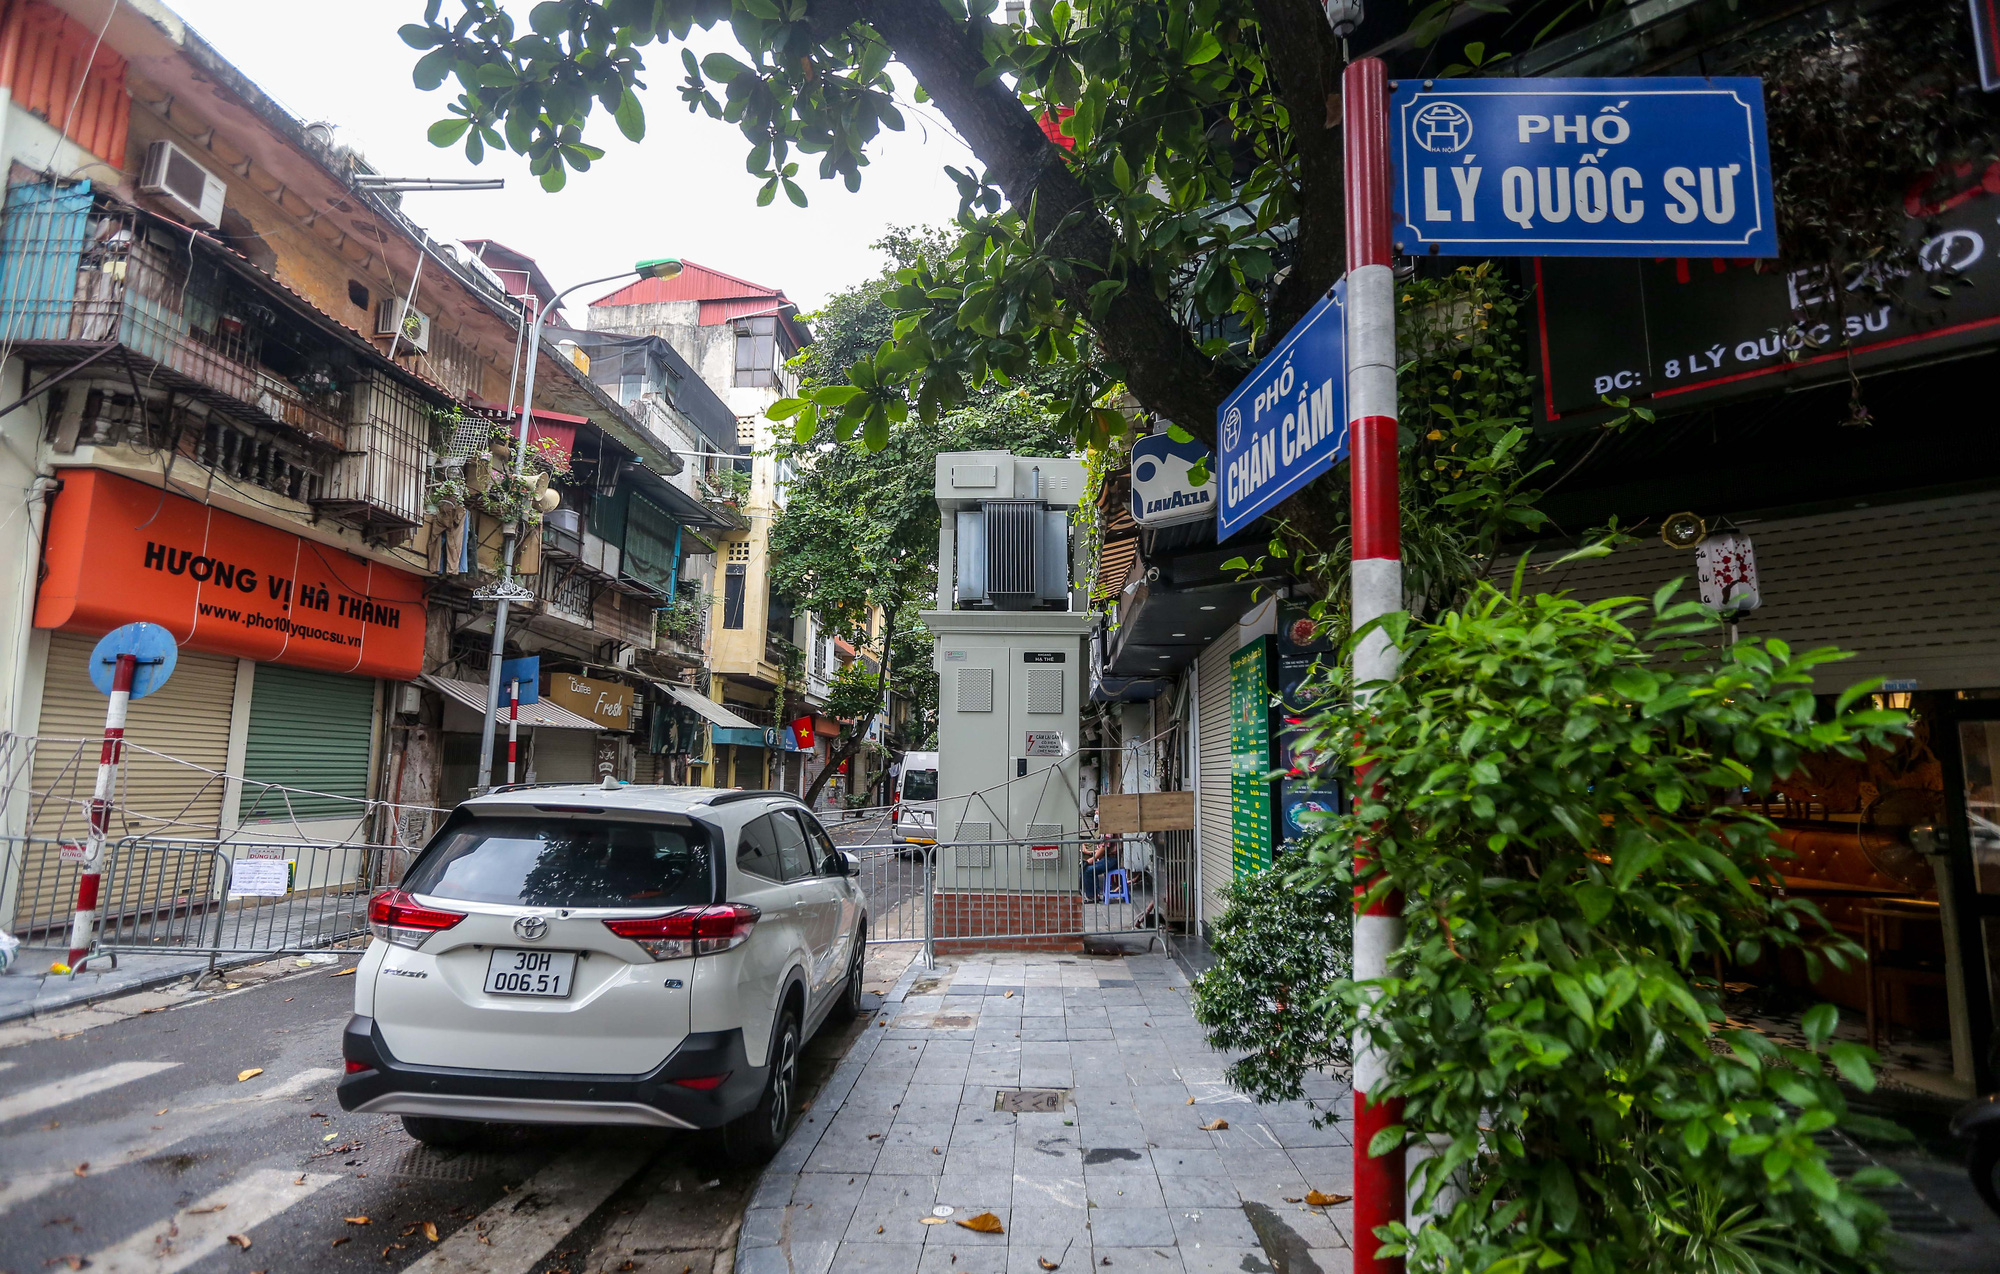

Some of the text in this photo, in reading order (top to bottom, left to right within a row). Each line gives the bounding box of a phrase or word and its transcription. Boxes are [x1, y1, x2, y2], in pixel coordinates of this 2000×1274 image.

[1518, 100, 1631, 145] PHỐ
[1424, 148, 1741, 230] LÝ QUỐC SƯ
[1594, 370, 1642, 395] ĐC:
[1664, 359, 1681, 379] 8
[1688, 344, 1726, 374] LÝ
[1842, 305, 1891, 338] SƯ
[1254, 349, 1295, 423] PHỐ
[1227, 377, 1334, 509] CHÂN CẦM
[1146, 490, 1210, 514] LAVAZZA
[144, 541, 400, 629] HƯƠNG VỊ HÀ THÀNH
[199, 603, 362, 648] www.pho10lyquocsu.vn
[571, 680, 591, 695] Coffee
[594, 692, 622, 717] Fresh
[494, 972, 560, 994] 006.51
[514, 952, 551, 972] 30H
